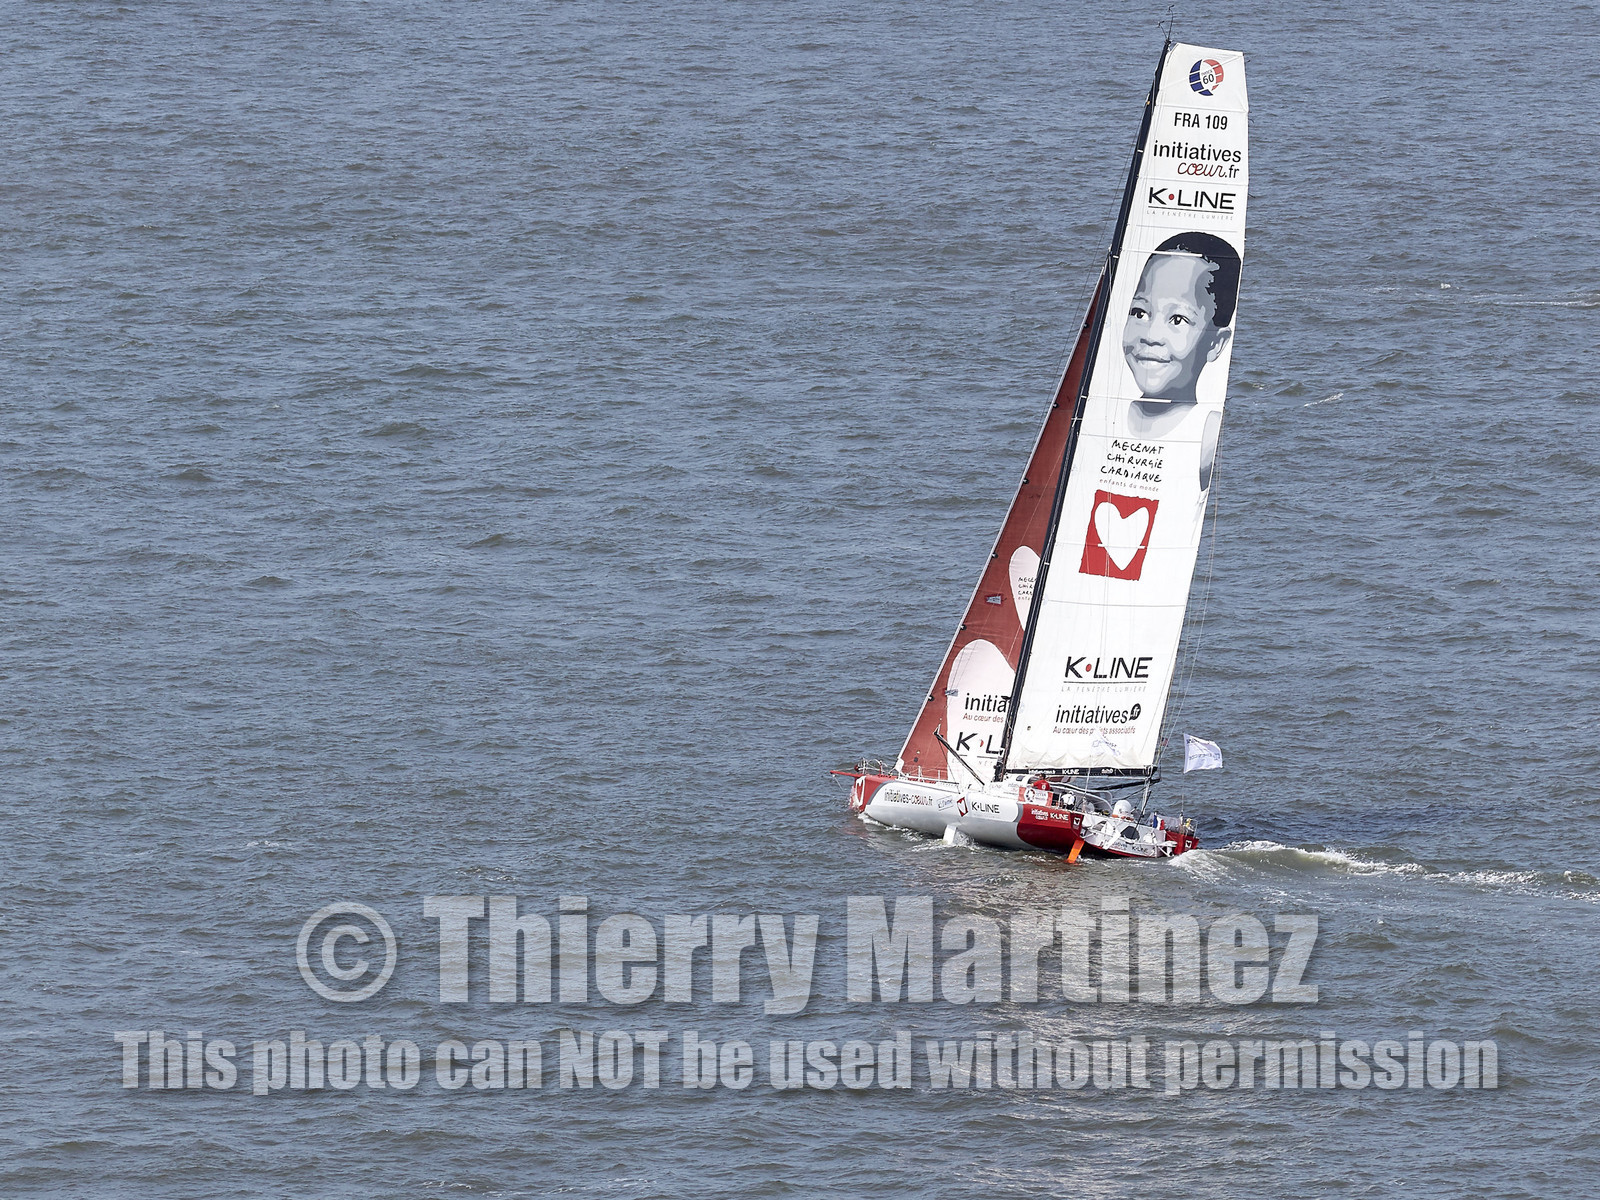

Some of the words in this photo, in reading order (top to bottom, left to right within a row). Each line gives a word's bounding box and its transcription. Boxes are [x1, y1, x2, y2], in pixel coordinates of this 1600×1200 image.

[1202, 73, 1215, 85] 60
[1174, 112, 1200, 128] FRA
[1205, 115, 1228, 130] 109
[1153, 140, 1242, 163] initiatives
[965, 693, 1010, 713] initia
[992, 715, 1004, 723] des
[1055, 704, 1129, 724] initiatives
